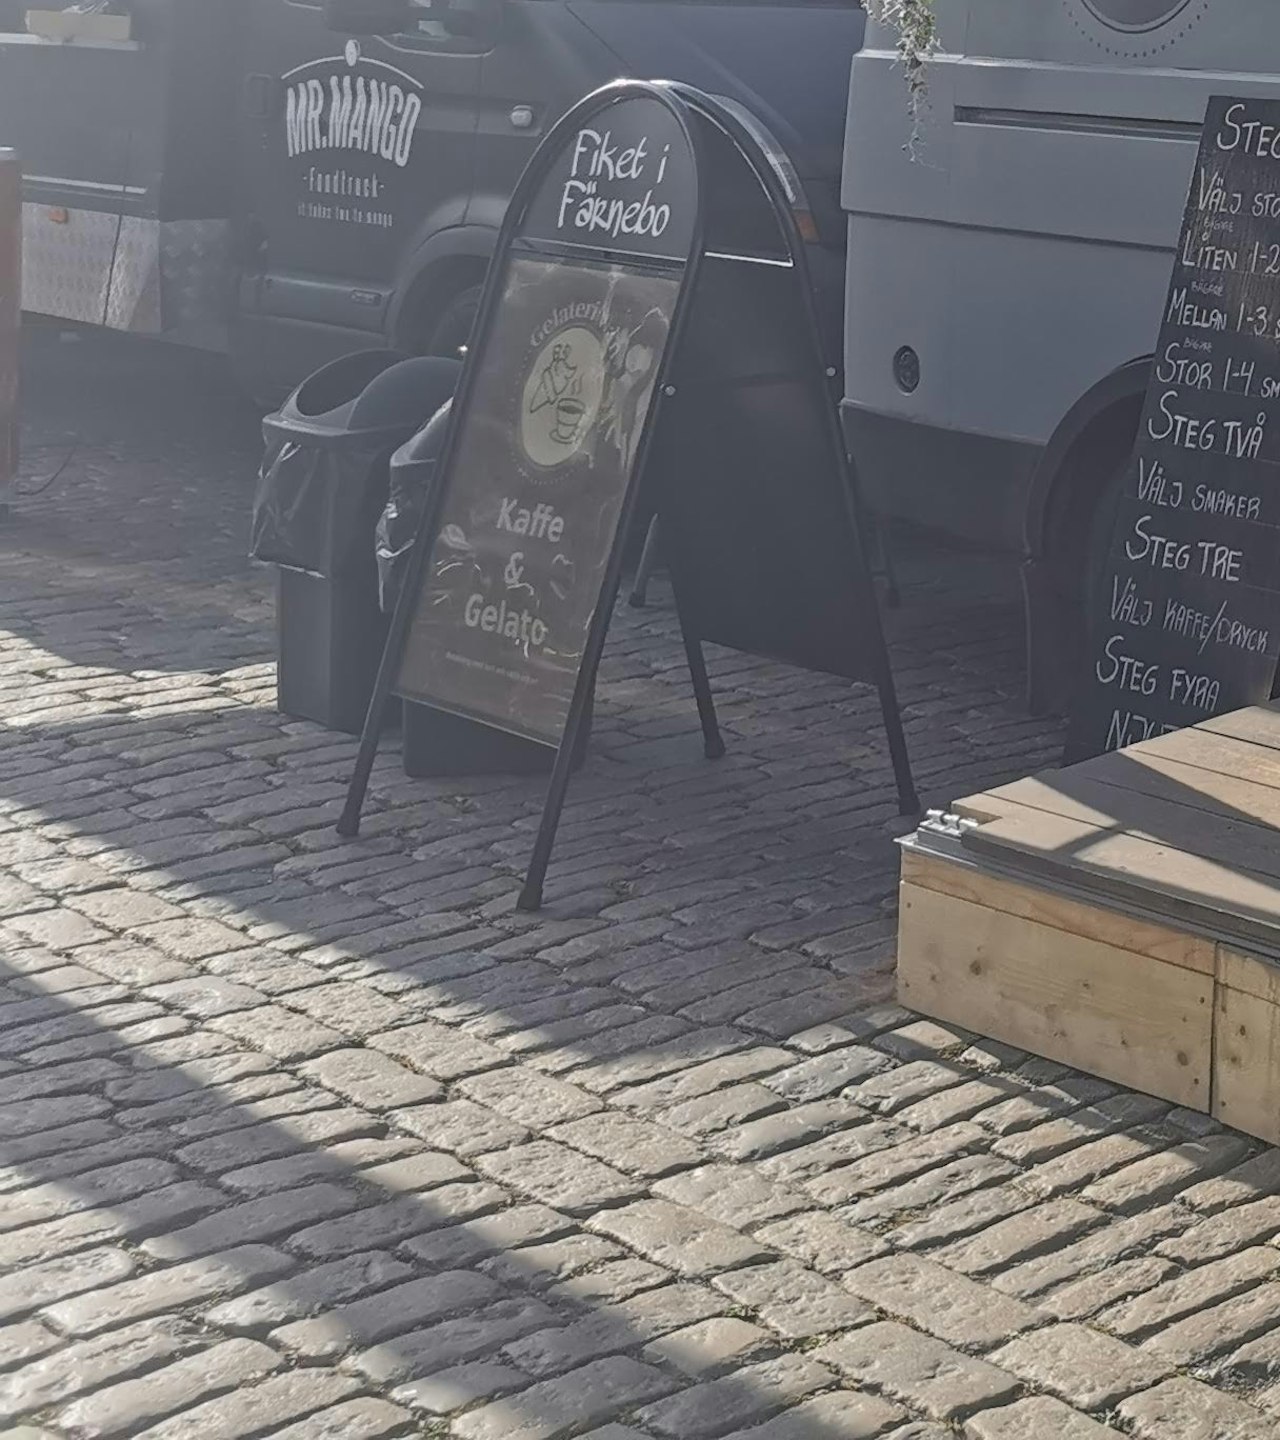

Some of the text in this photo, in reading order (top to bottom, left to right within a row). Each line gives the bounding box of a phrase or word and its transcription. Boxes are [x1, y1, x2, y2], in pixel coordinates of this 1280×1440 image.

[286, 75, 421, 167] MR.MANGO
[571, 129, 670, 183] Fiket i
[558, 180, 670, 238] Färnebo
[1200, 167, 1242, 214] VÄLJ
[1181, 230, 1237, 271] LITEN
[1250, 242, 1280, 274] 1-2
[1167, 287, 1227, 331] MELLAN
[1236, 302, 1268, 335] 1-3
[1157, 342, 1212, 389] STOR
[1223, 358, 1254, 396] 1-4
[1148, 390, 1266, 459] STEG TVÅ
[1138, 458, 1261, 519] VÄLJ SMAKER
[495, 497, 565, 543] Kaffe
[504, 551, 524, 585] &
[1125, 515, 1243, 583] STEG TRE
[464, 593, 547, 646] Gelato
[1110, 574, 1269, 656] VÄLJ KAFFE/DRYCK
[1096, 635, 1220, 711] STEG FYRA
